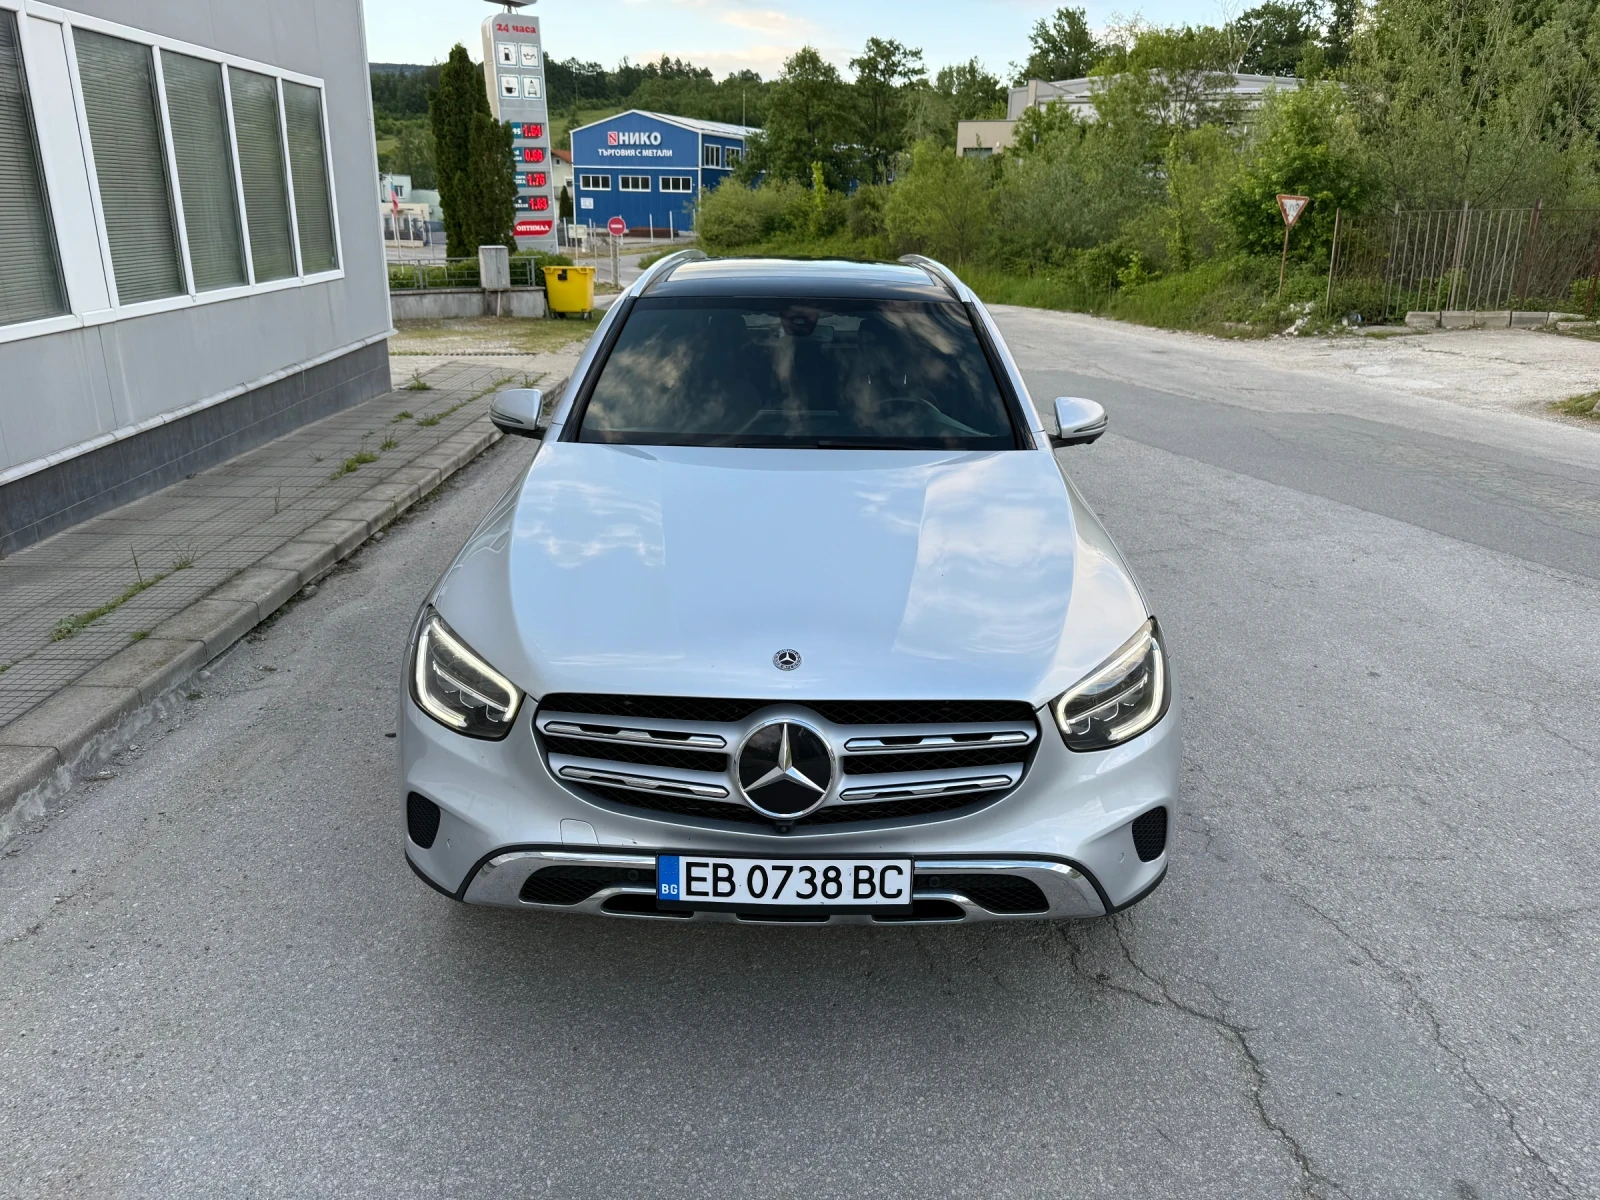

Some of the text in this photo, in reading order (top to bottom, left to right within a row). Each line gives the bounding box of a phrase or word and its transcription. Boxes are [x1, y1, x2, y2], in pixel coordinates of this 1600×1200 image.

[496, 23, 537, 34] 24 часа
[619, 131, 662, 146] НИКО
[597, 148, 673, 157] ТЪРГОВИЯ С МЕТАЛИ
[516, 224, 550, 232] ОПТИМАЛ
[685, 861, 904, 900] EB 0738 BC
[661, 883, 678, 895] BG
